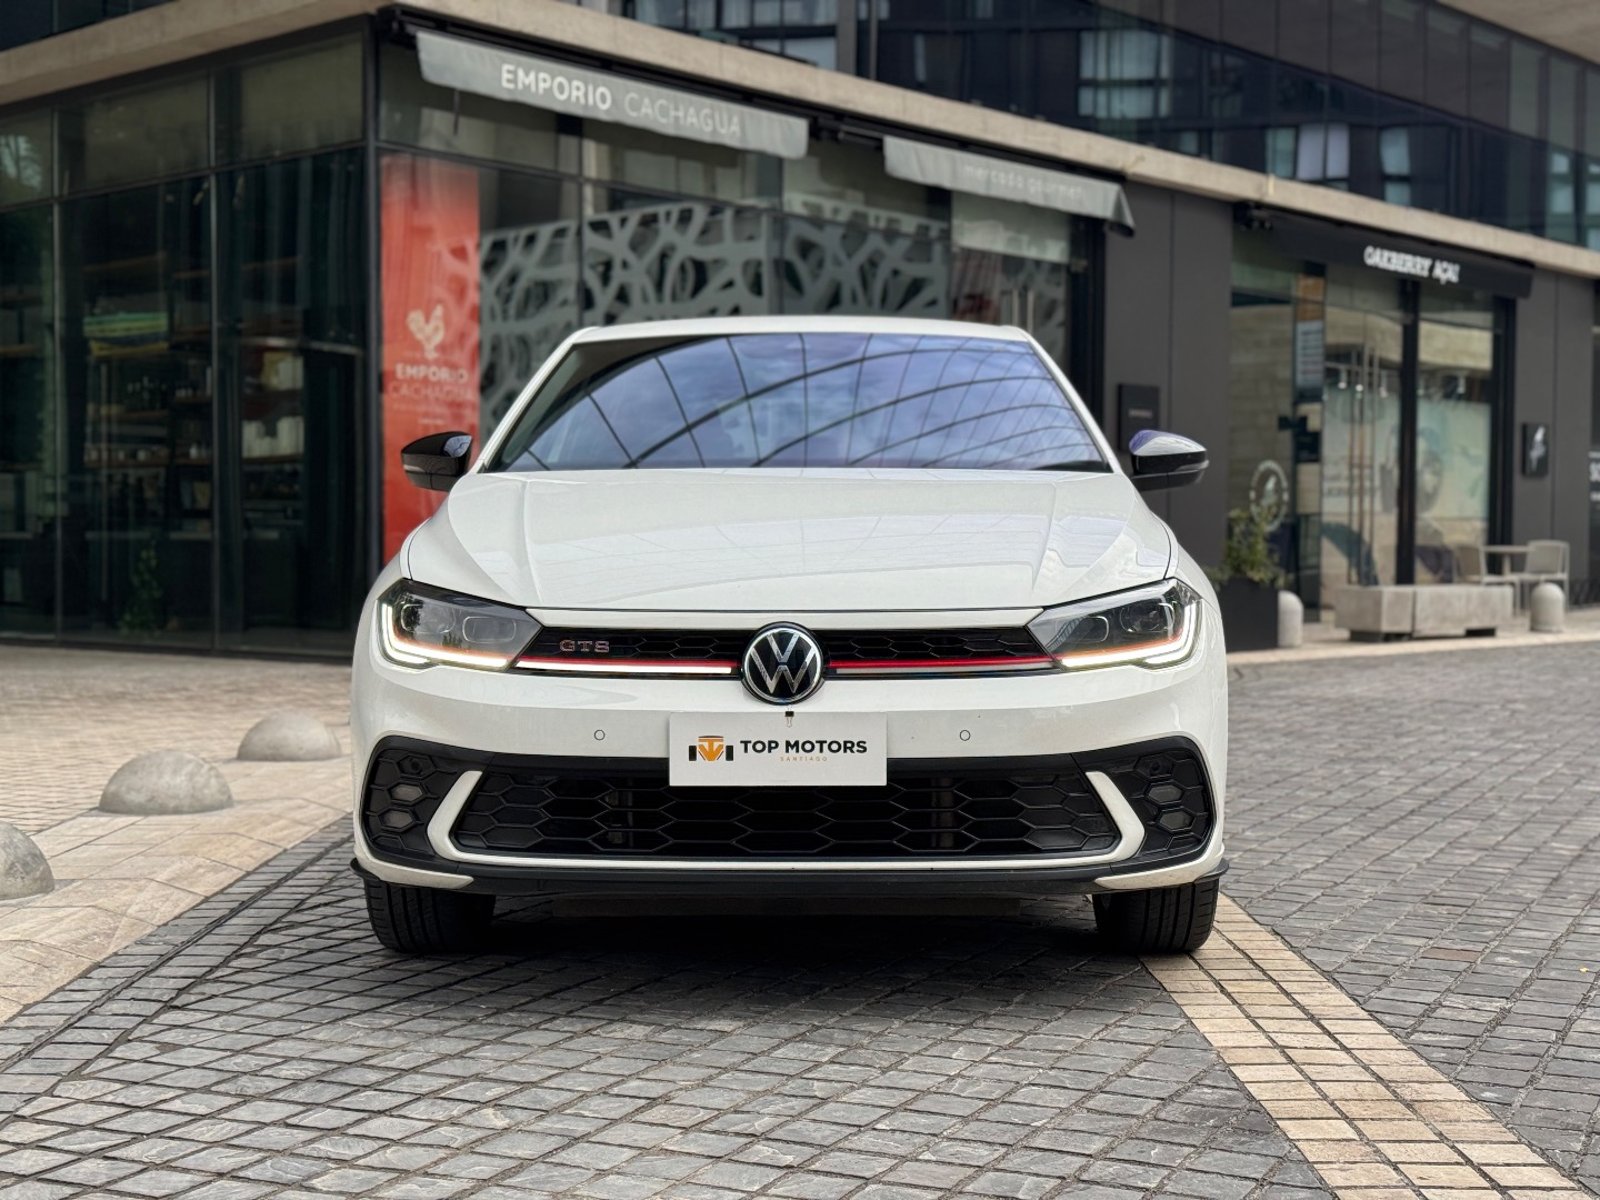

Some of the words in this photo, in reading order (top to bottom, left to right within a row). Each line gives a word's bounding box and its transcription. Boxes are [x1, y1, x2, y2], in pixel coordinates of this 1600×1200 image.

[501, 63, 612, 110] EMPORIO
[624, 92, 741, 138] CACHAGUA
[559, 639, 610, 653] GTS
[740, 740, 779, 754] TOP
[785, 740, 868, 754] MOTORS
